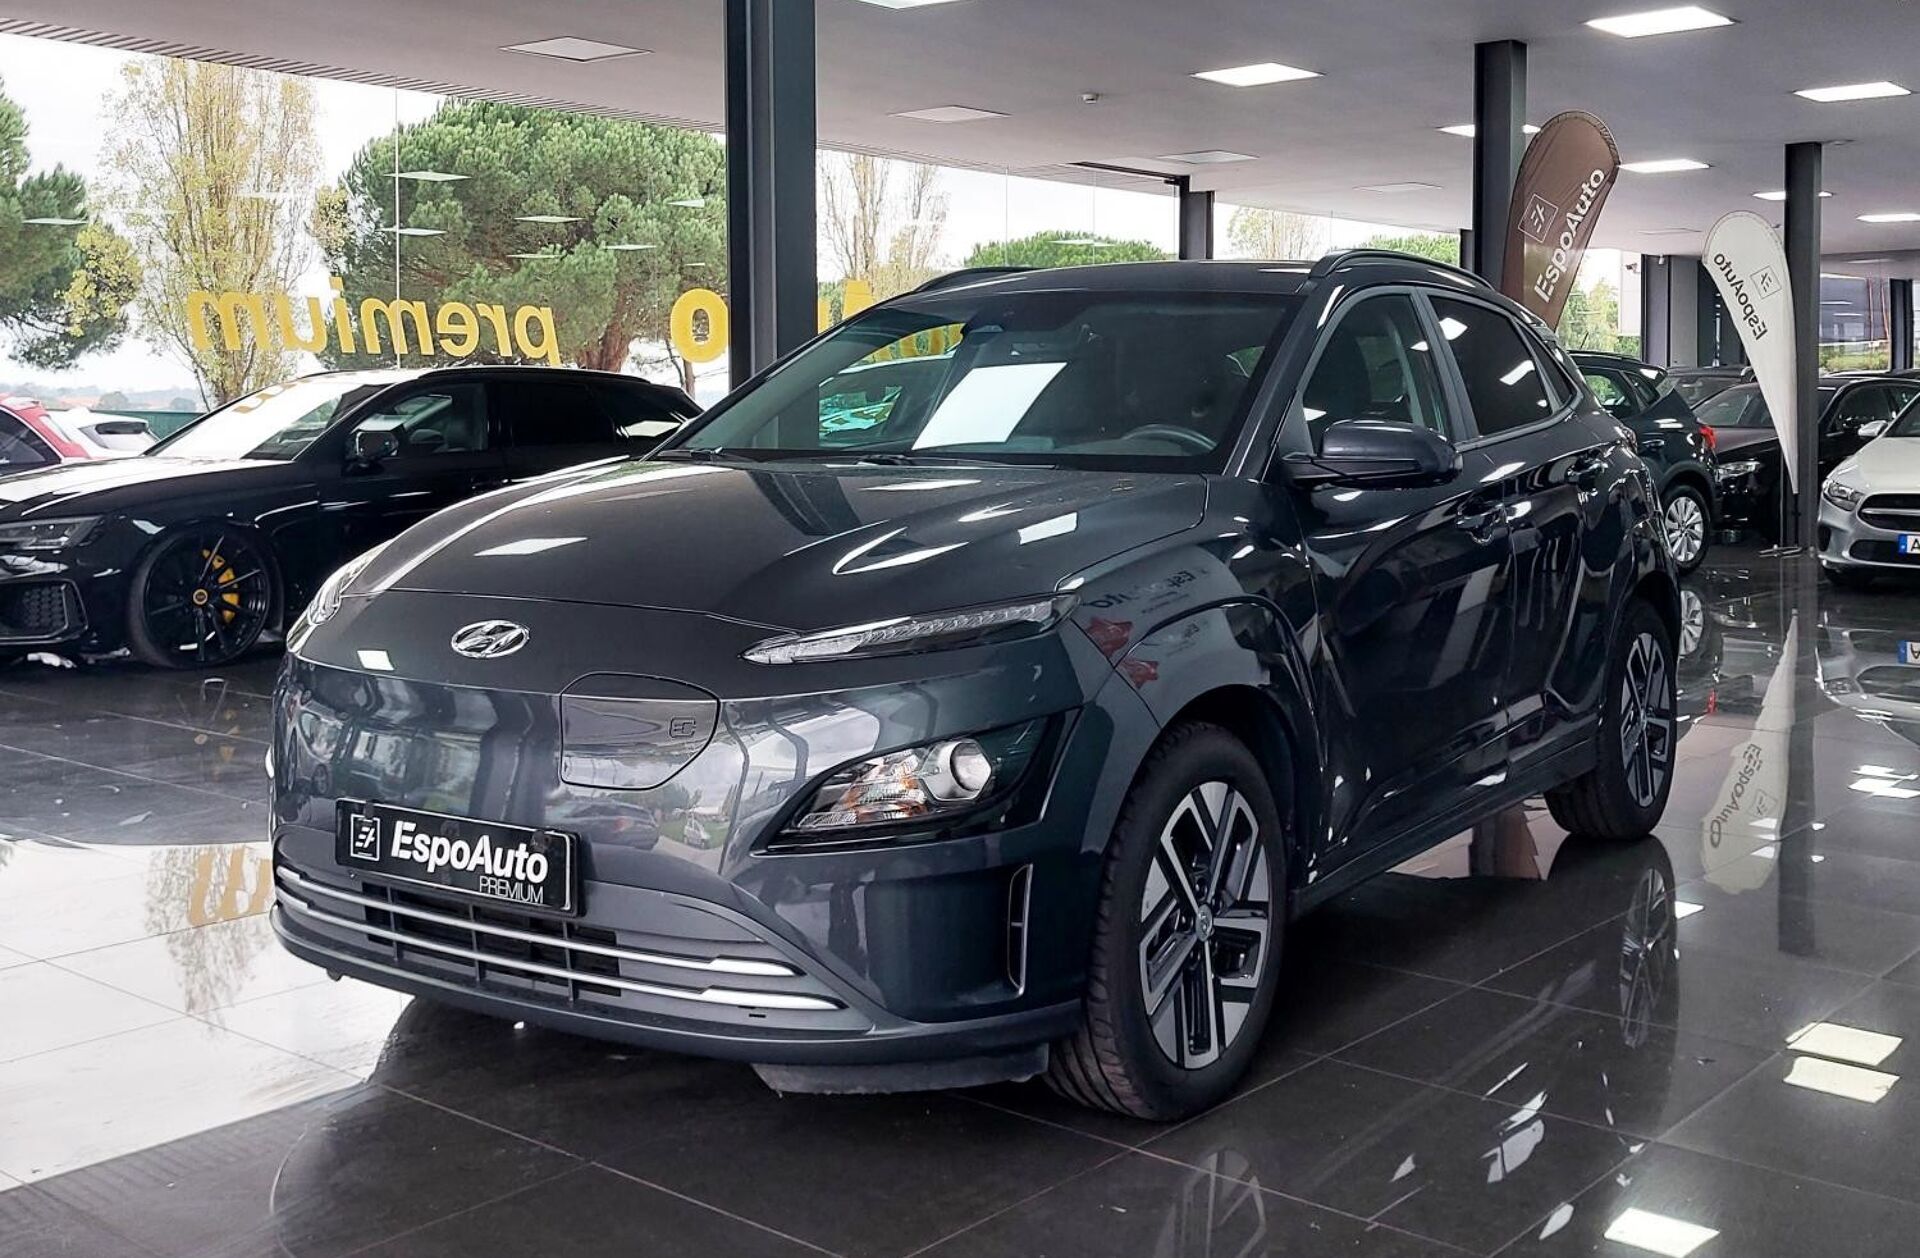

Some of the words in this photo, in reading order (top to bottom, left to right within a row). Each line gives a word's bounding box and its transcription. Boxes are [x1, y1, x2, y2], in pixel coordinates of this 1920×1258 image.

[1534, 169, 1605, 303] EspoAuto
[391, 820, 549, 884] EspoAuto
[478, 875, 545, 904] PREMIUM
